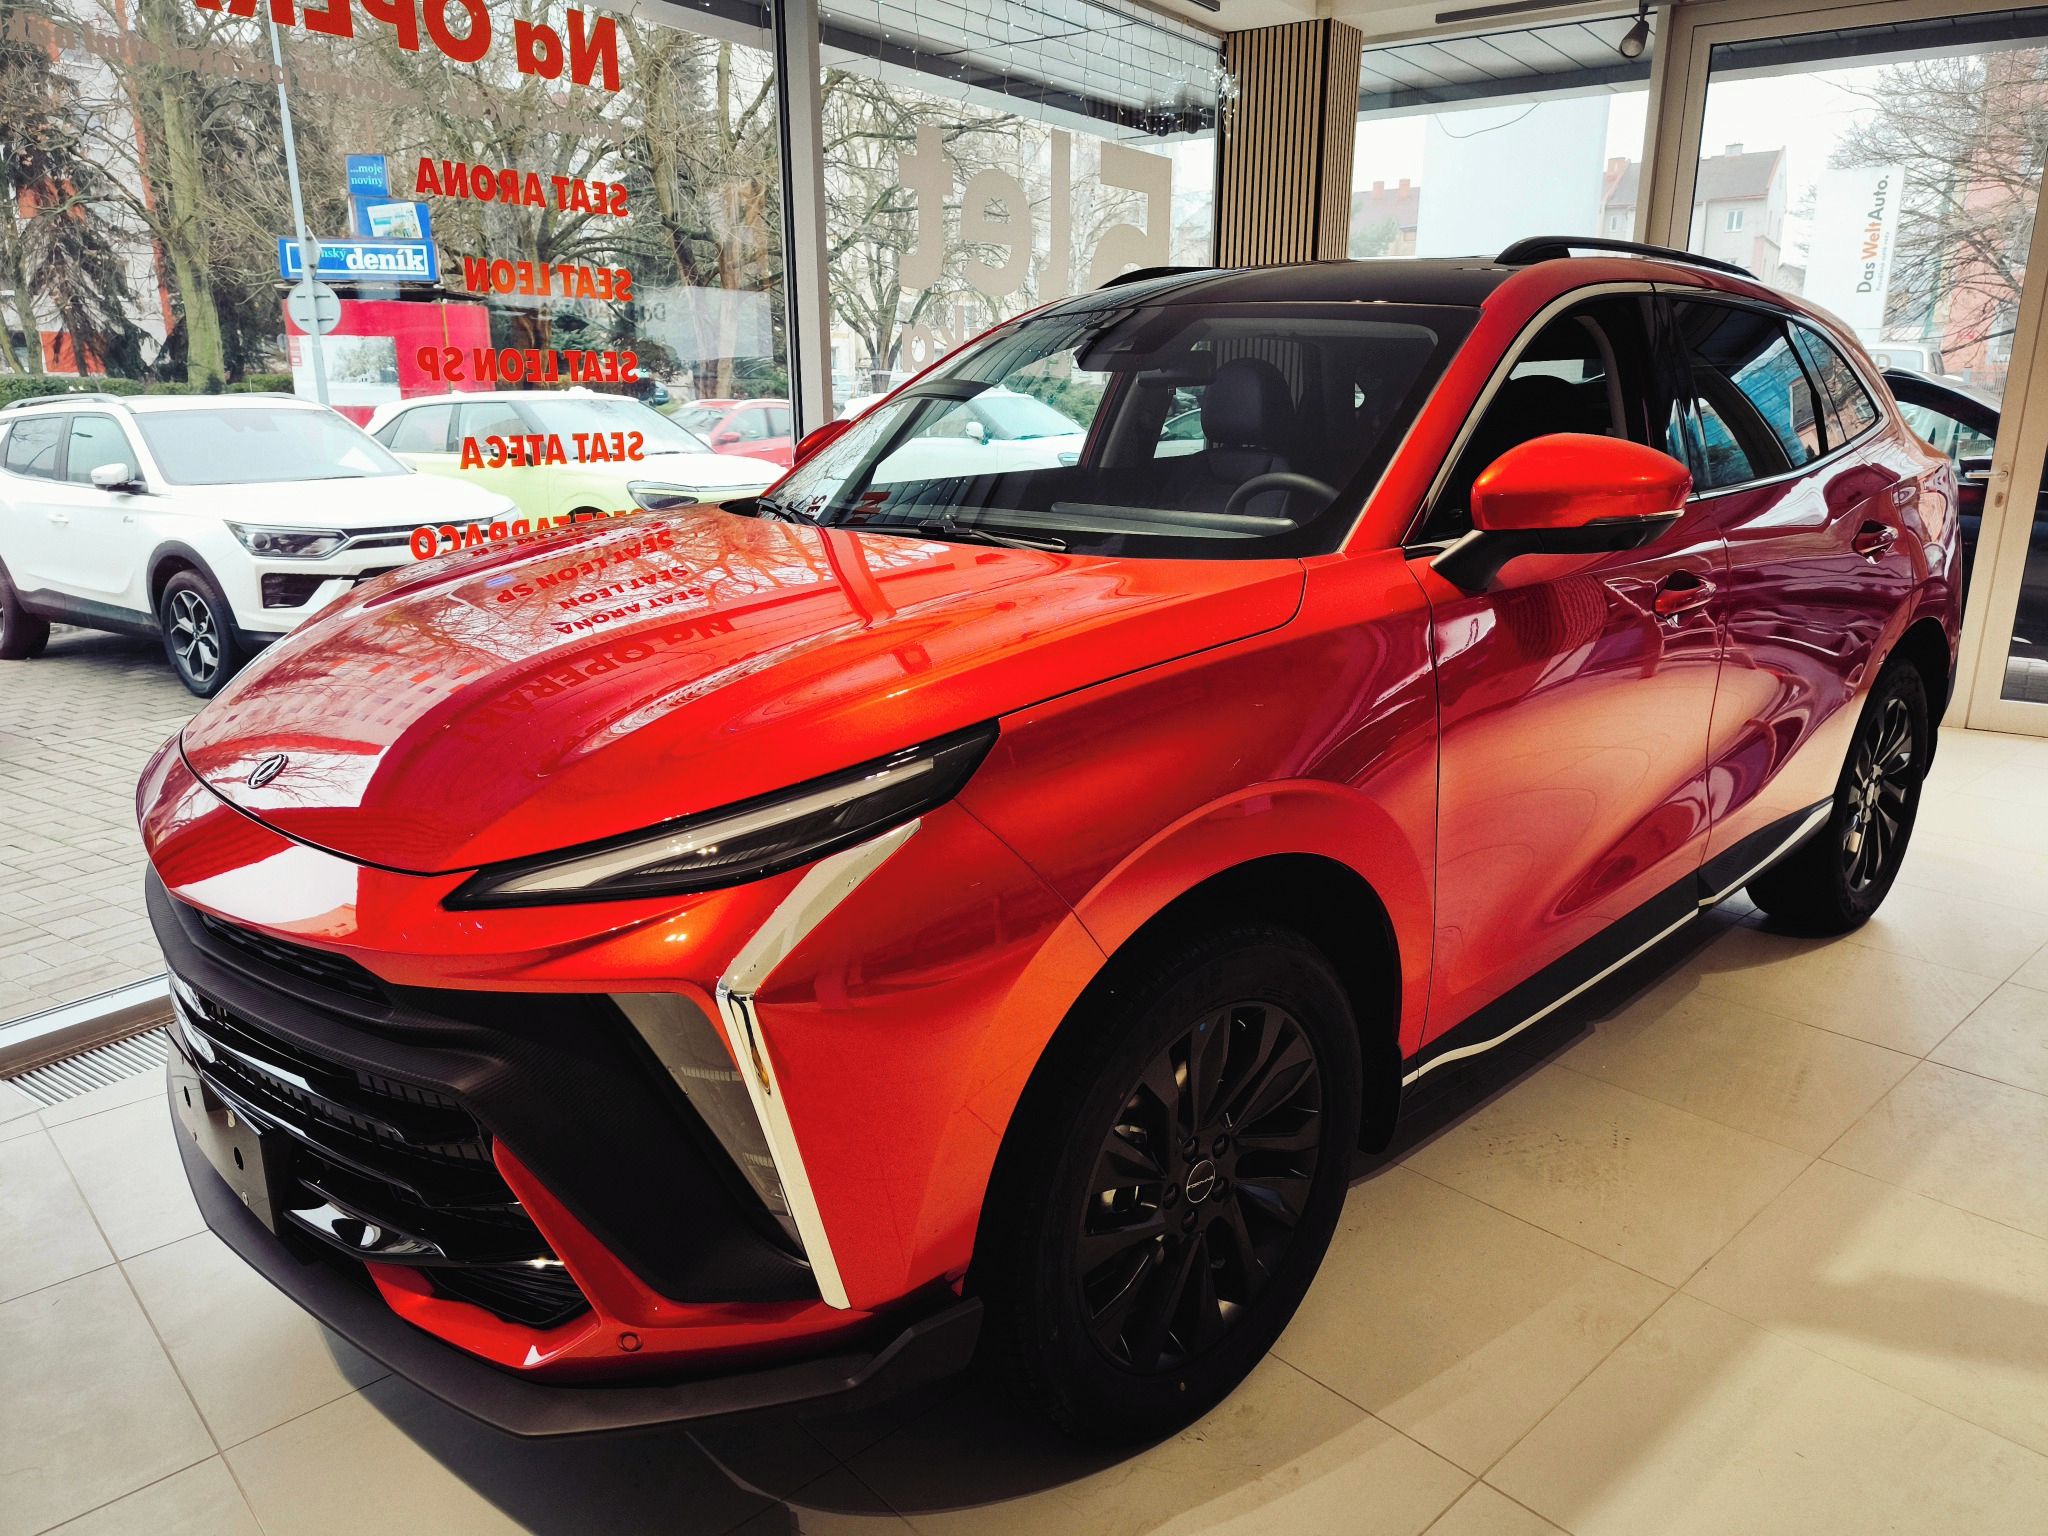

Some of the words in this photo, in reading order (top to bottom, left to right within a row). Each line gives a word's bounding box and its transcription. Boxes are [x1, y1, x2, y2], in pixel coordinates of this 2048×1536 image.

[351, 176, 384, 187] noviny
[346, 248, 425, 271] deník
[1856, 262, 1876, 293] Das
[612, 530, 675, 564] SEAT
[535, 558, 608, 590] LEON
[630, 566, 688, 590] SEAT
[496, 583, 534, 604] SP
[558, 584, 625, 610] LEON
[648, 587, 705, 609] SEAT
[554, 602, 641, 635] ARONA
